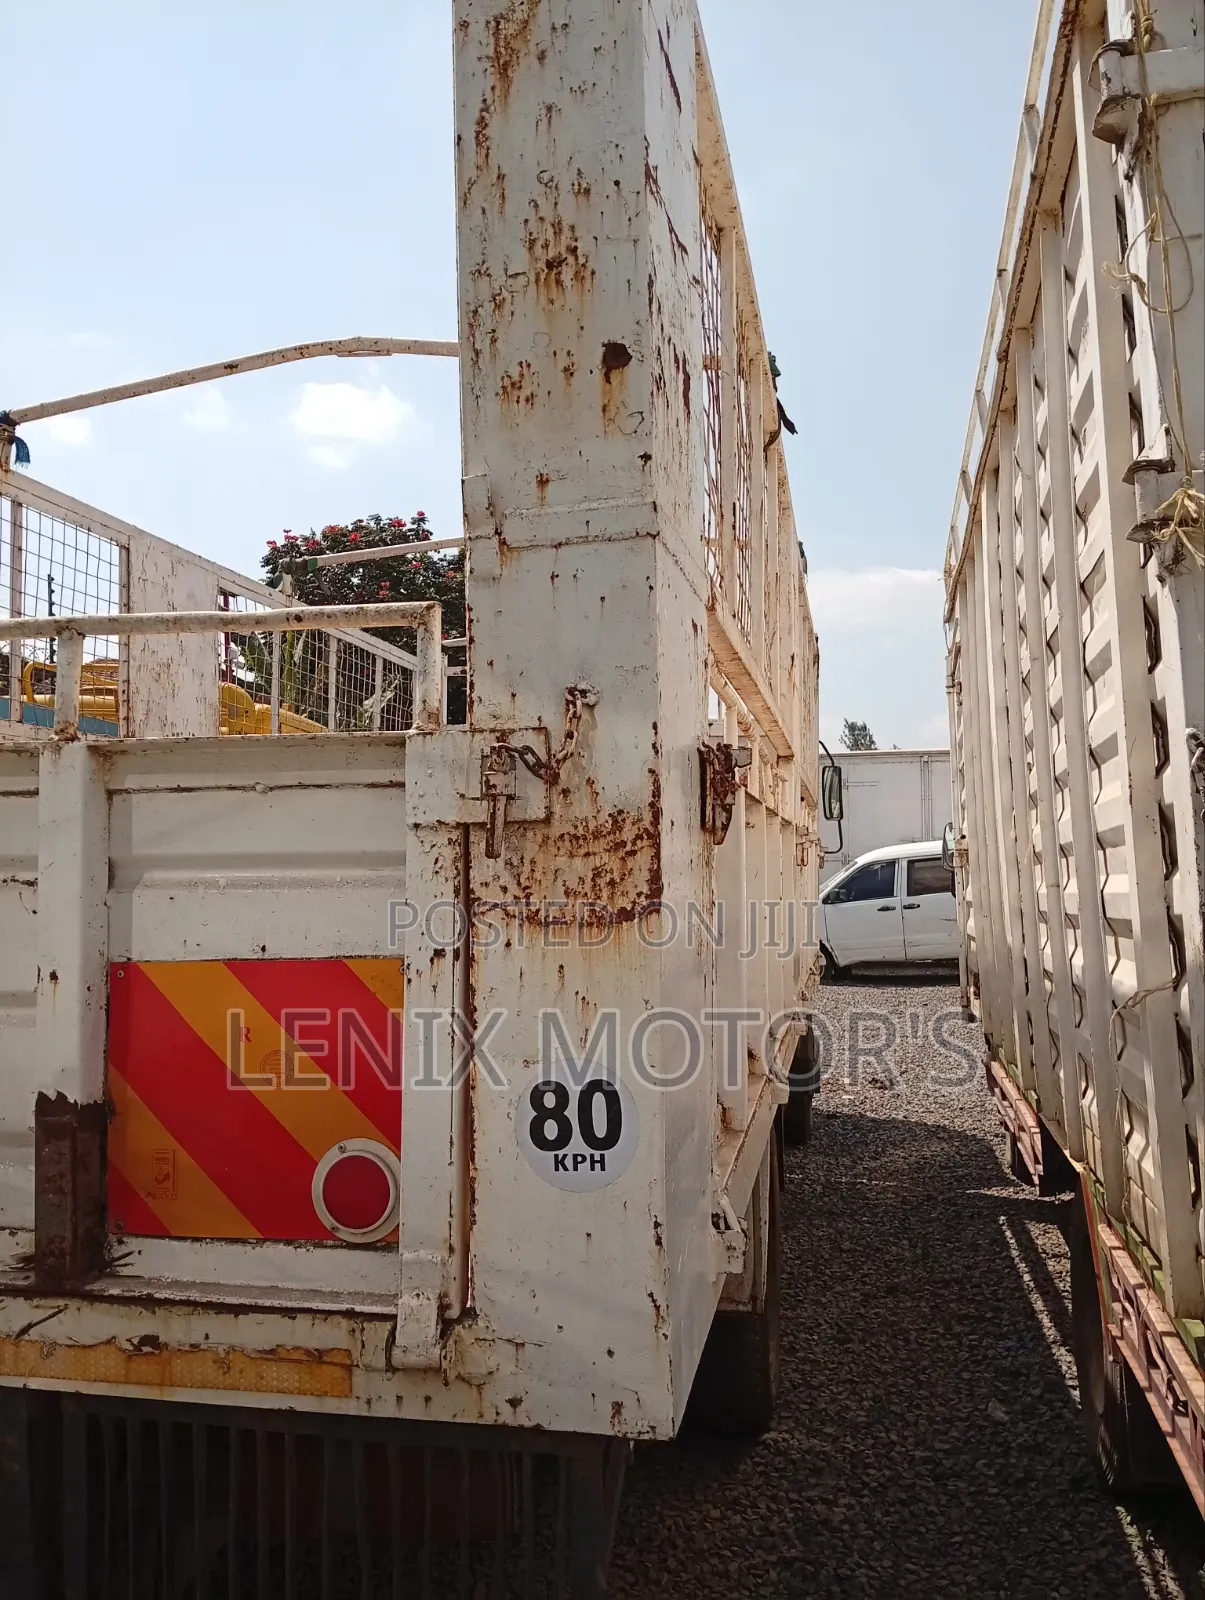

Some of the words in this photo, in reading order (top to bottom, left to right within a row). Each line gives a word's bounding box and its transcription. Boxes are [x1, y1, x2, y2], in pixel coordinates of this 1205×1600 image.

[238, 1026, 252, 1043] R
[528, 1080, 623, 1152] 80
[553, 1153, 606, 1172] KPH
